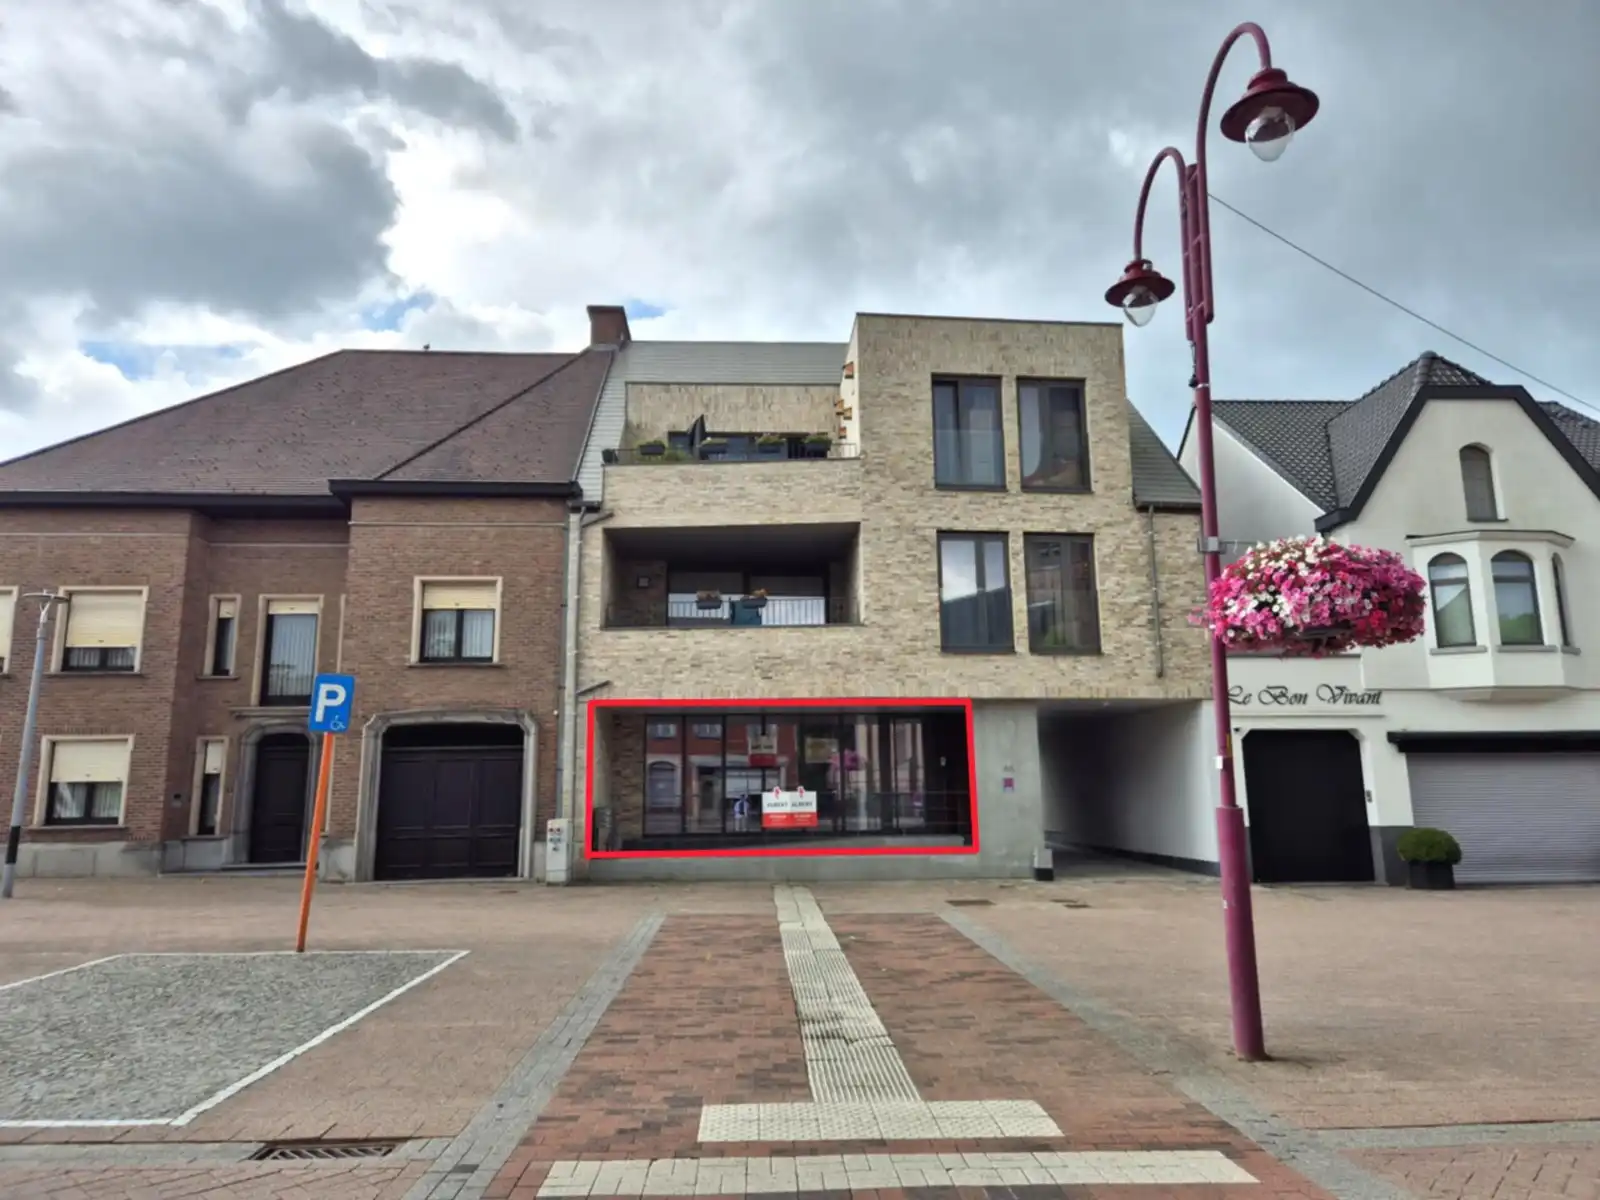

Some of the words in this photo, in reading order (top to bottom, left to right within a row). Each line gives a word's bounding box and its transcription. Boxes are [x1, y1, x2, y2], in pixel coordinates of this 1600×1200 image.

[315, 683, 346, 723] P
[1228, 685, 1252, 705] Le
[1258, 685, 1308, 706] Bon
[1316, 683, 1383, 705] Vivant
